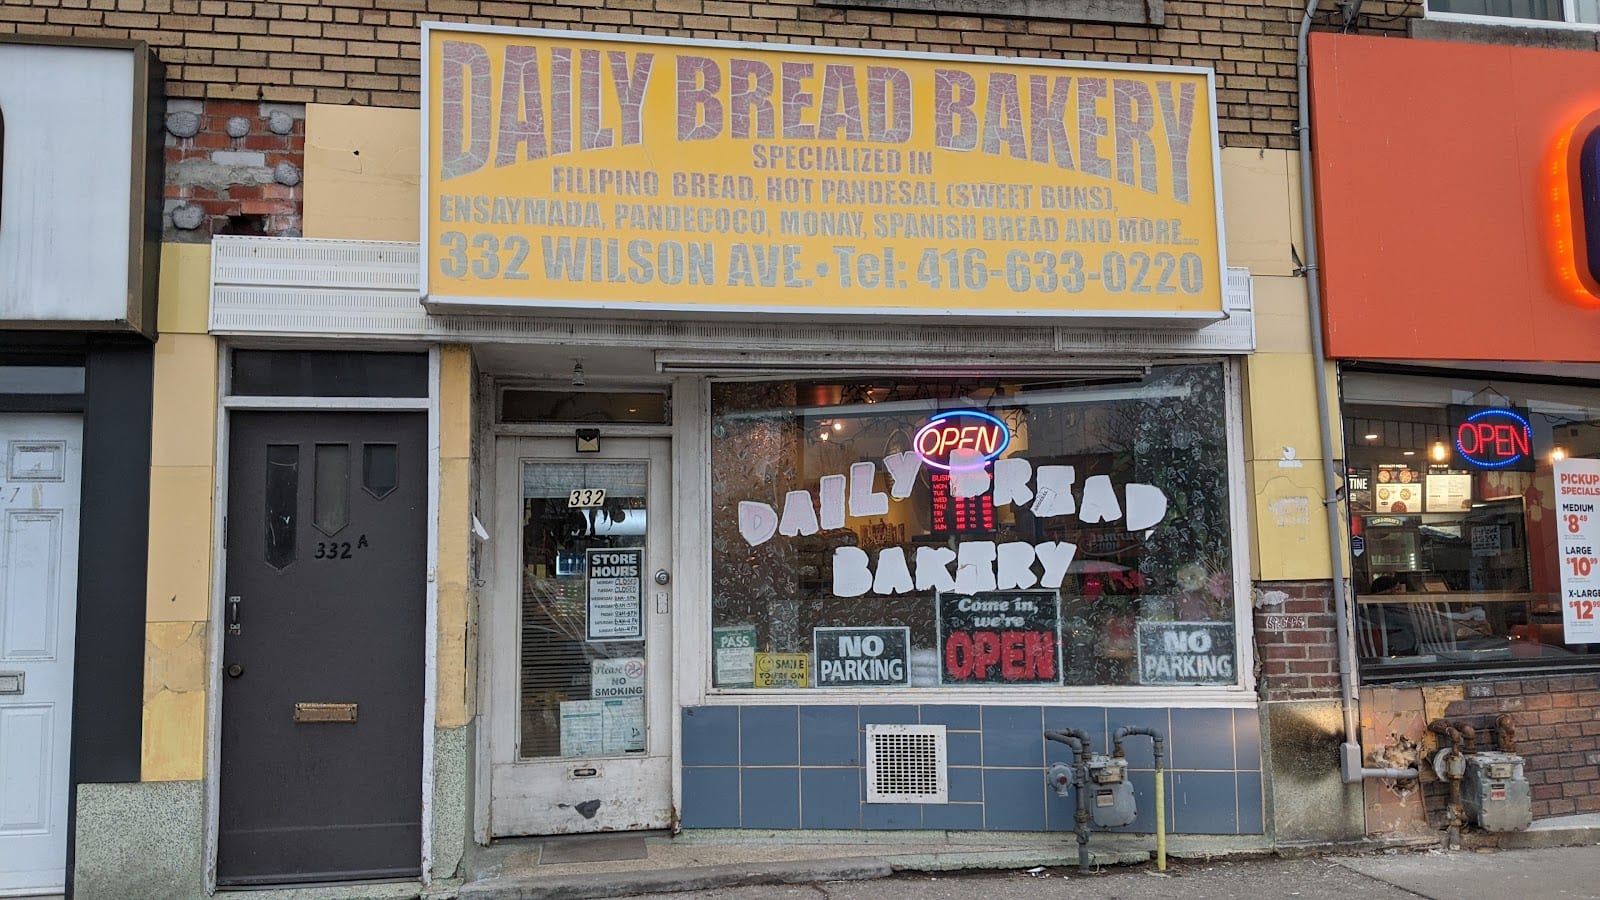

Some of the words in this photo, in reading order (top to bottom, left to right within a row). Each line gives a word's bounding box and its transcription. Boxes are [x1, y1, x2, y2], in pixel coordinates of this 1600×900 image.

[440, 40, 655, 181] DAILY
[676, 54, 912, 144] BREAD
[934, 69, 1196, 205] BAKERY
[752, 144, 901, 174] SPECIALIZED
[909, 151, 932, 176] IN
[551, 166, 659, 197] FILIPINO
[673, 172, 759, 202] BREAD,
[766, 176, 813, 203] HOT
[821, 178, 940, 207] PANDESAL
[440, 195, 608, 231] ENSAYMADA,
[615, 204, 772, 237] PANDECOCO,
[780, 210, 867, 240] MONAY,
[873, 211, 976, 240] SPANISH
[982, 215, 1059, 242] BREAD
[1065, 216, 1111, 244] AND
[1118, 218, 1199, 245] MORE...
[440, 231, 530, 281] 332
[541, 235, 715, 286] WILSON
[727, 242, 813, 288] AVE.
[832, 246, 907, 289] Tel:
[916, 247, 1203, 295] 416-633-0220
[919, 426, 999, 456] OPEN
[1459, 424, 1529, 455] OPEN
[1561, 473, 1600, 485] PICKUP
[570, 490, 604, 506] 332
[738, 451, 923, 546] DAILY
[949, 448, 1167, 531] BREAD
[1561, 486, 1600, 496] SPECIALS
[1562, 503, 1594, 512] MEDIUM
[314, 542, 352, 560] 332
[358, 534, 369, 549] A
[1565, 546, 1592, 555] LARGE
[592, 553, 637, 565] STORE
[592, 566, 638, 577] HOURS
[832, 541, 1077, 597] BAKERY
[958, 598, 1010, 612] Come
[1012, 597, 1039, 614] in,
[974, 614, 1025, 628] we're
[720, 635, 750, 648] PASS
[838, 635, 884, 657] NO
[1164, 630, 1212, 653] NO
[775, 659, 805, 670] SMILE
[946, 630, 1056, 680] OPEN
[594, 663, 623, 675] Please
[821, 658, 904, 682] PARKING
[1145, 654, 1233, 678] PARKING
[612, 677, 626, 686] NO
[790, 672, 804, 680] ON
[594, 687, 643, 697] SMOKING
